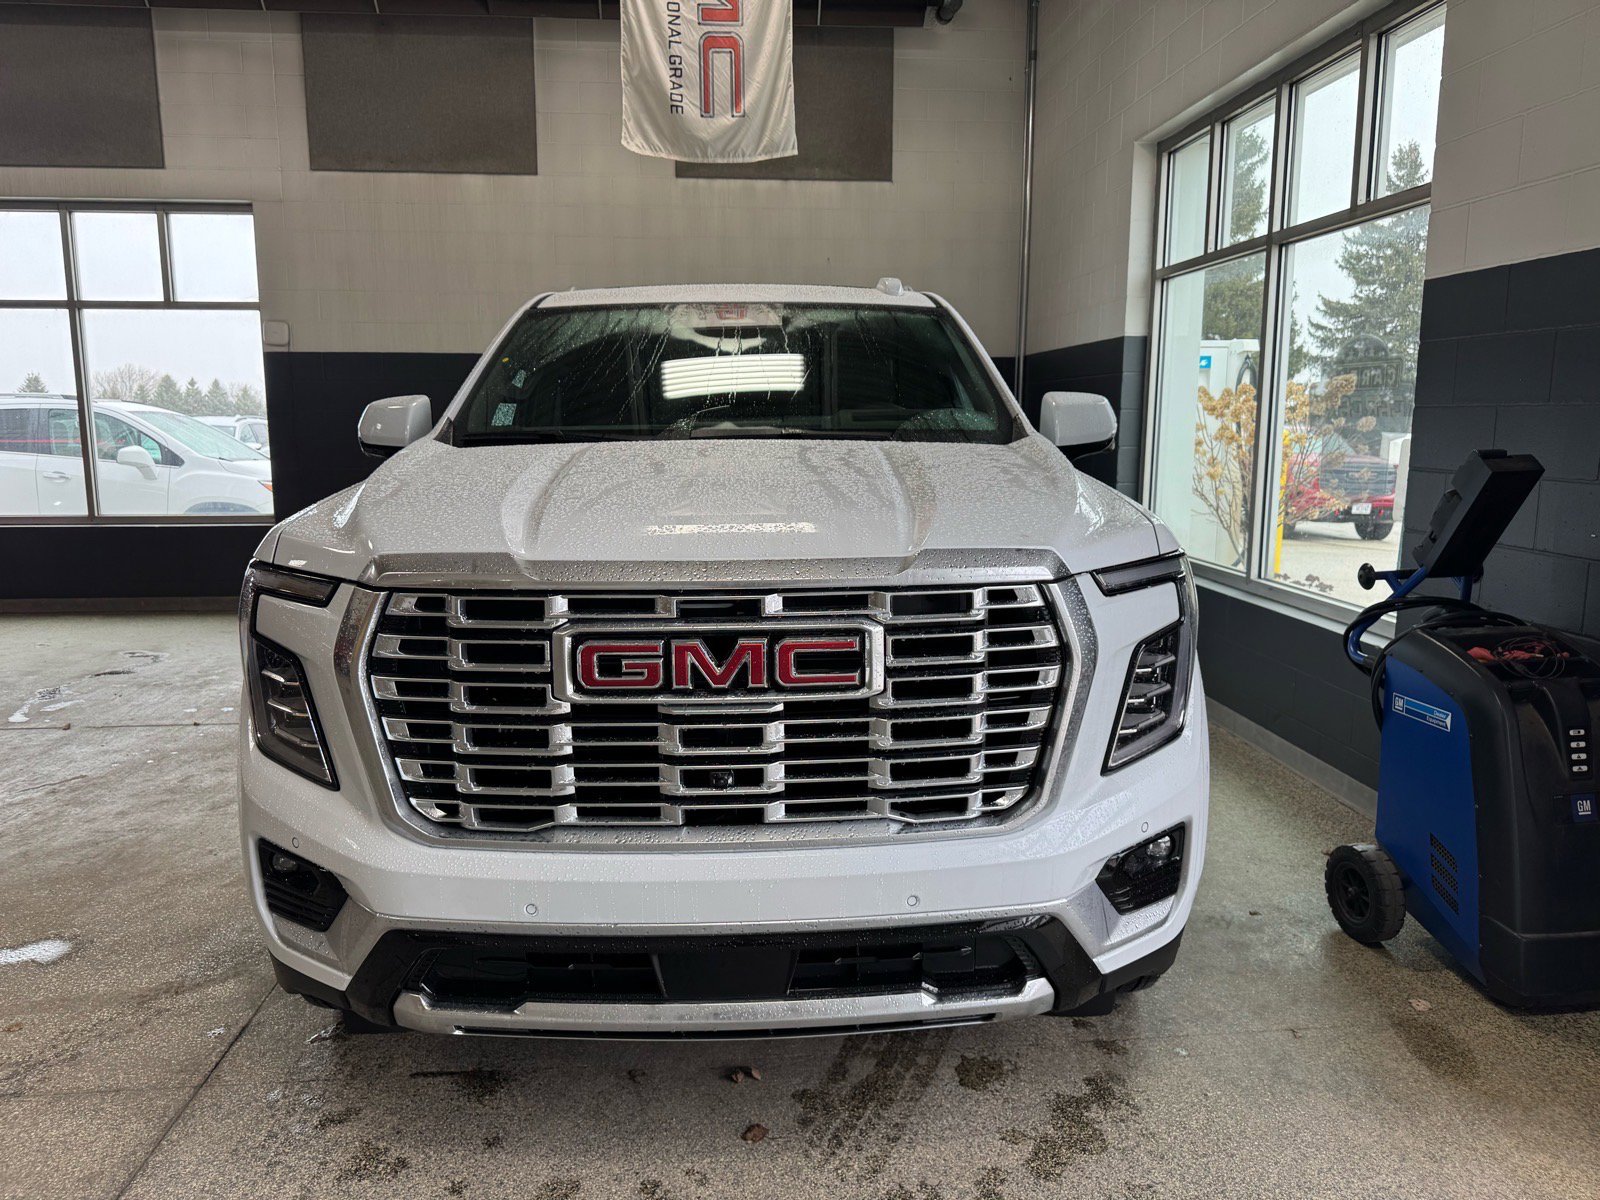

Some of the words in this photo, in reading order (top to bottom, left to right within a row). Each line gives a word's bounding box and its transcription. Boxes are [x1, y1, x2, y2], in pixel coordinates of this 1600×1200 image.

[668, 54, 684, 114] GRADE
[577, 637, 861, 689] GMC
[1577, 800, 1591, 812] GM
